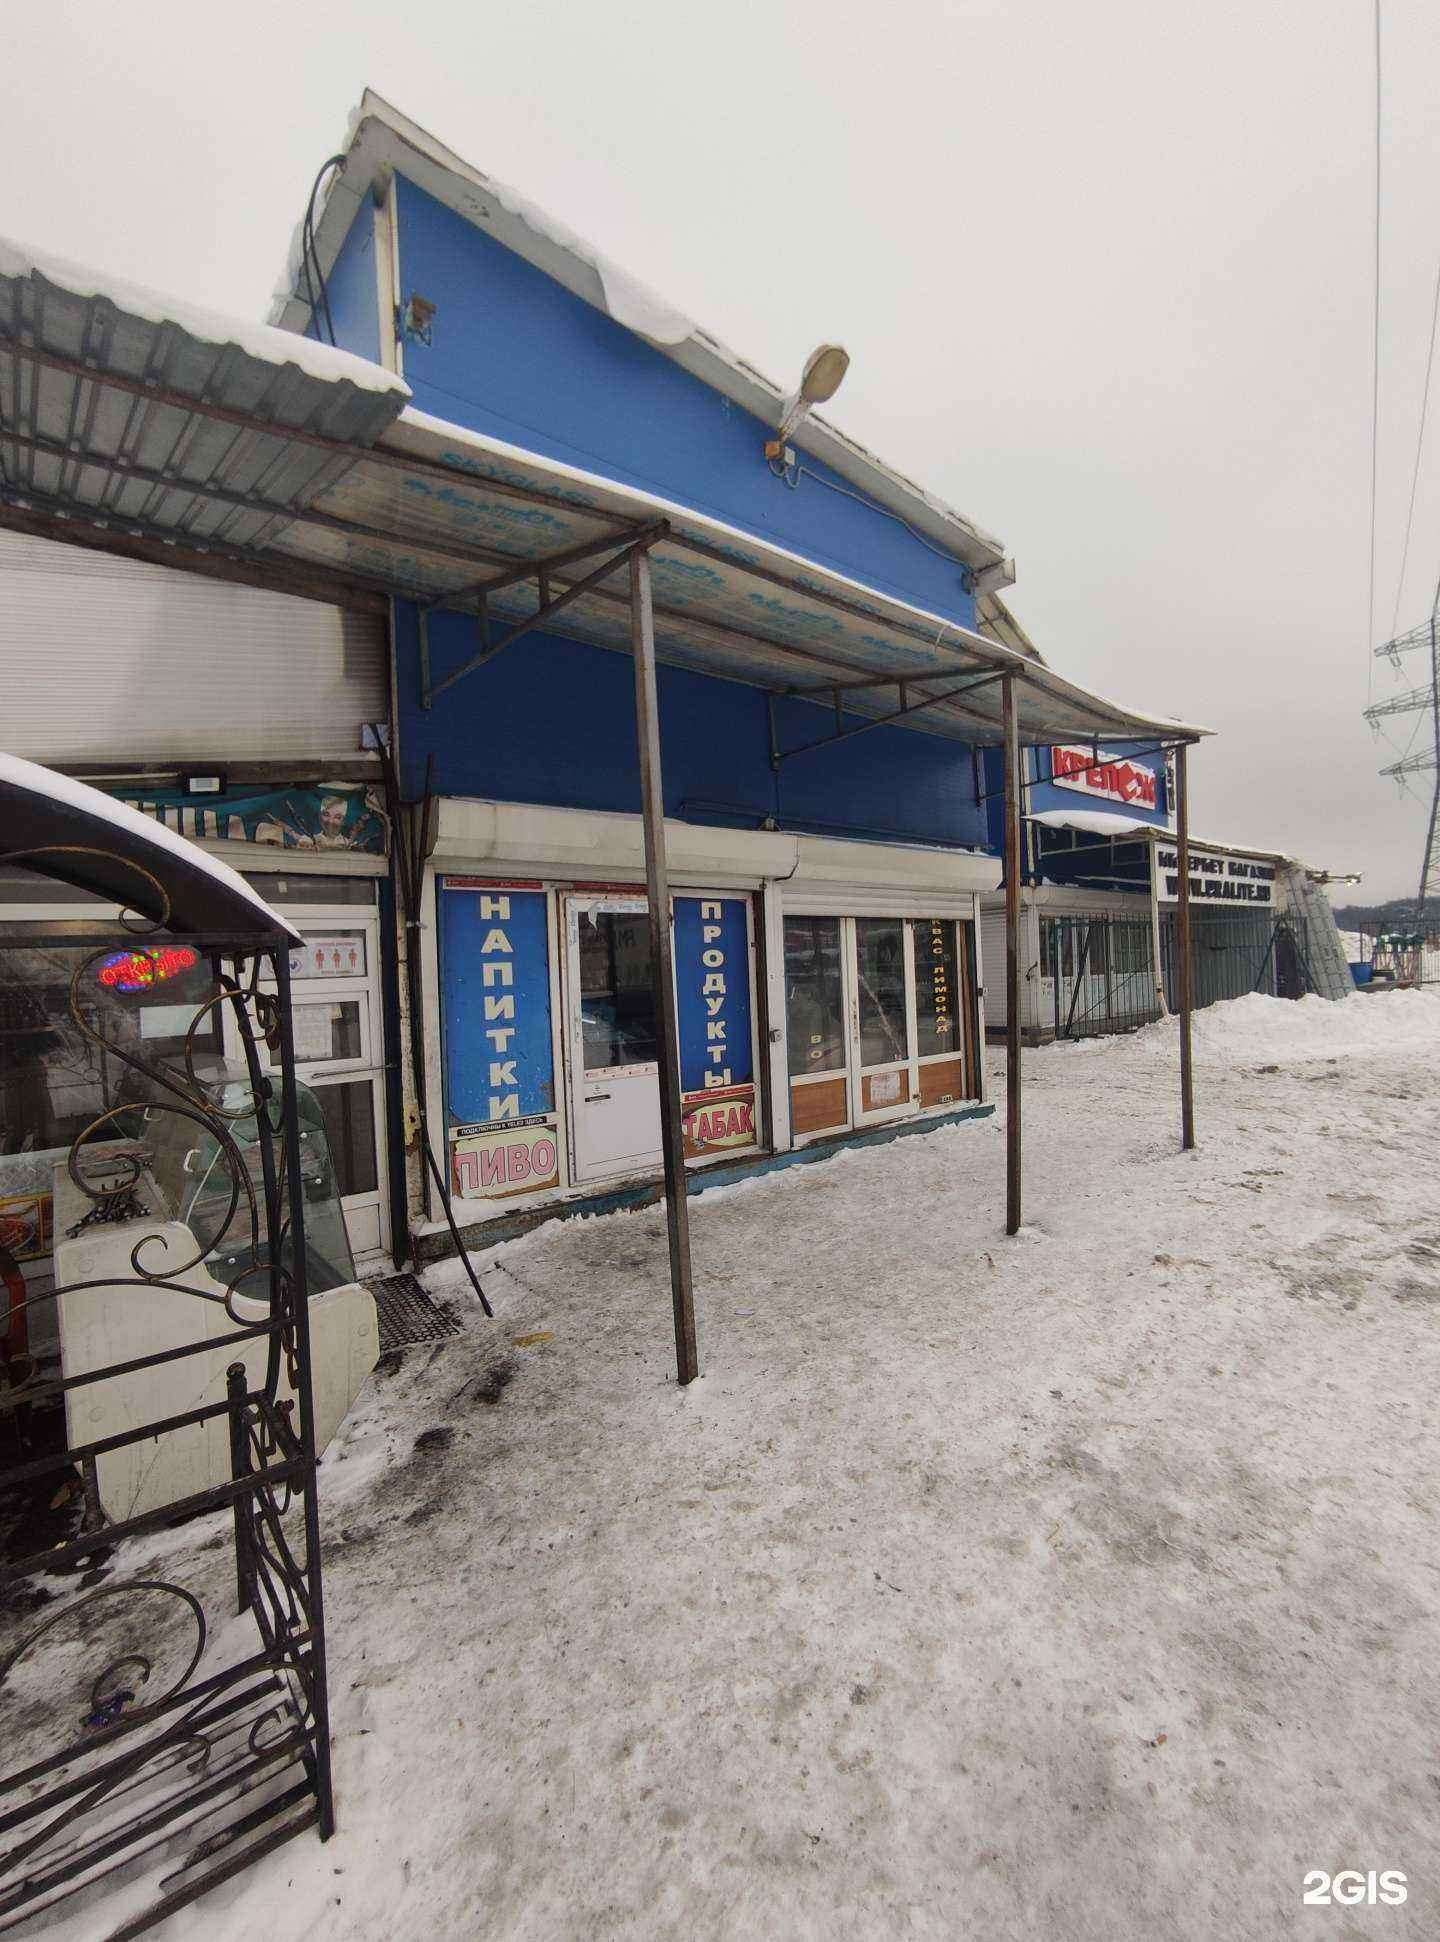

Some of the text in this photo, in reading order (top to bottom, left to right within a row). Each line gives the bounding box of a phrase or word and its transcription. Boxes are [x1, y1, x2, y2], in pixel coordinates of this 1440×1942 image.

[1158, 851, 1225, 874] ИНЕРНЕТ
[480, 896, 520, 1121] НАПИТКИ
[701, 901, 732, 1088] ПРОДУКТЫ
[682, 1102, 753, 1142] ТАБАК
[453, 1138, 556, 1189] ПИВО
